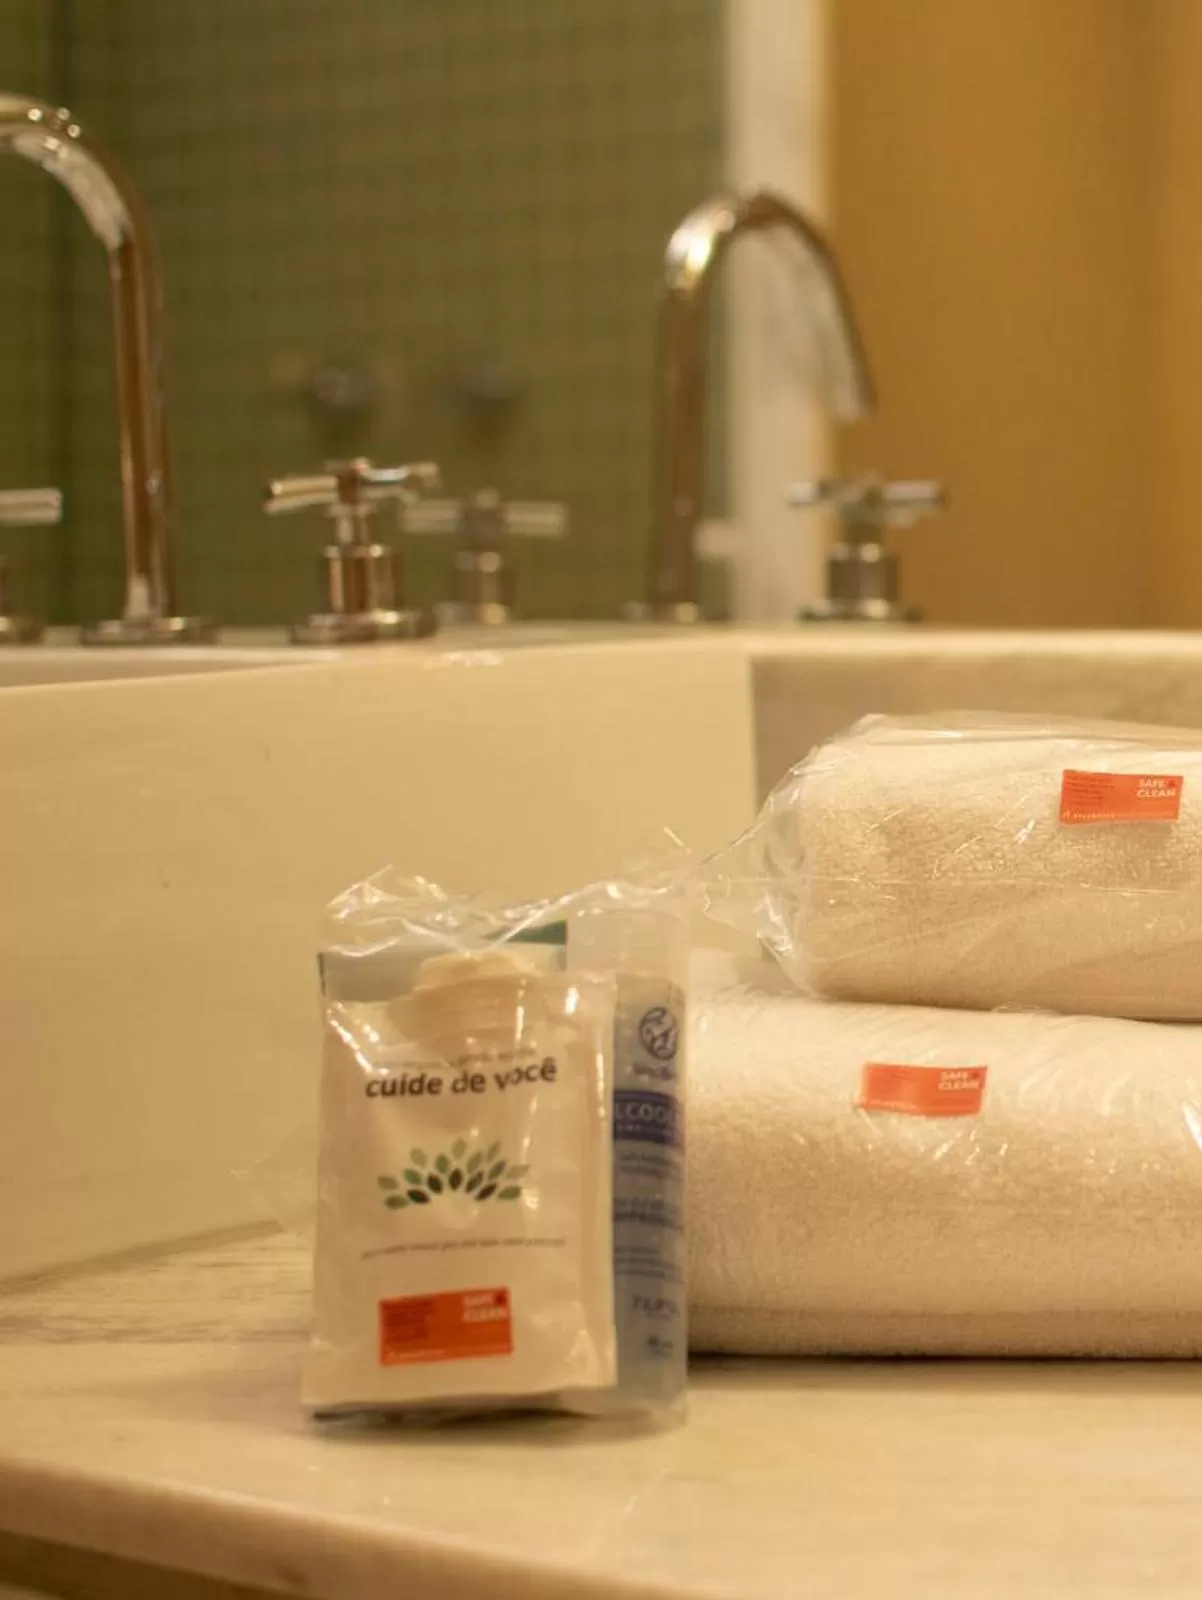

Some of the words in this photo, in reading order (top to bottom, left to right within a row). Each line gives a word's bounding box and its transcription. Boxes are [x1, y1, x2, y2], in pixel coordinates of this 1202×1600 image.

[1138, 778, 1165, 788] SAFE
[1136, 788, 1177, 798] CLEAN
[365, 1073, 444, 1098] cuide
[451, 1070, 486, 1094] de
[493, 1055, 558, 1091] você
[941, 1070, 968, 1080] SAFE
[937, 1080, 981, 1090] CLEAN
